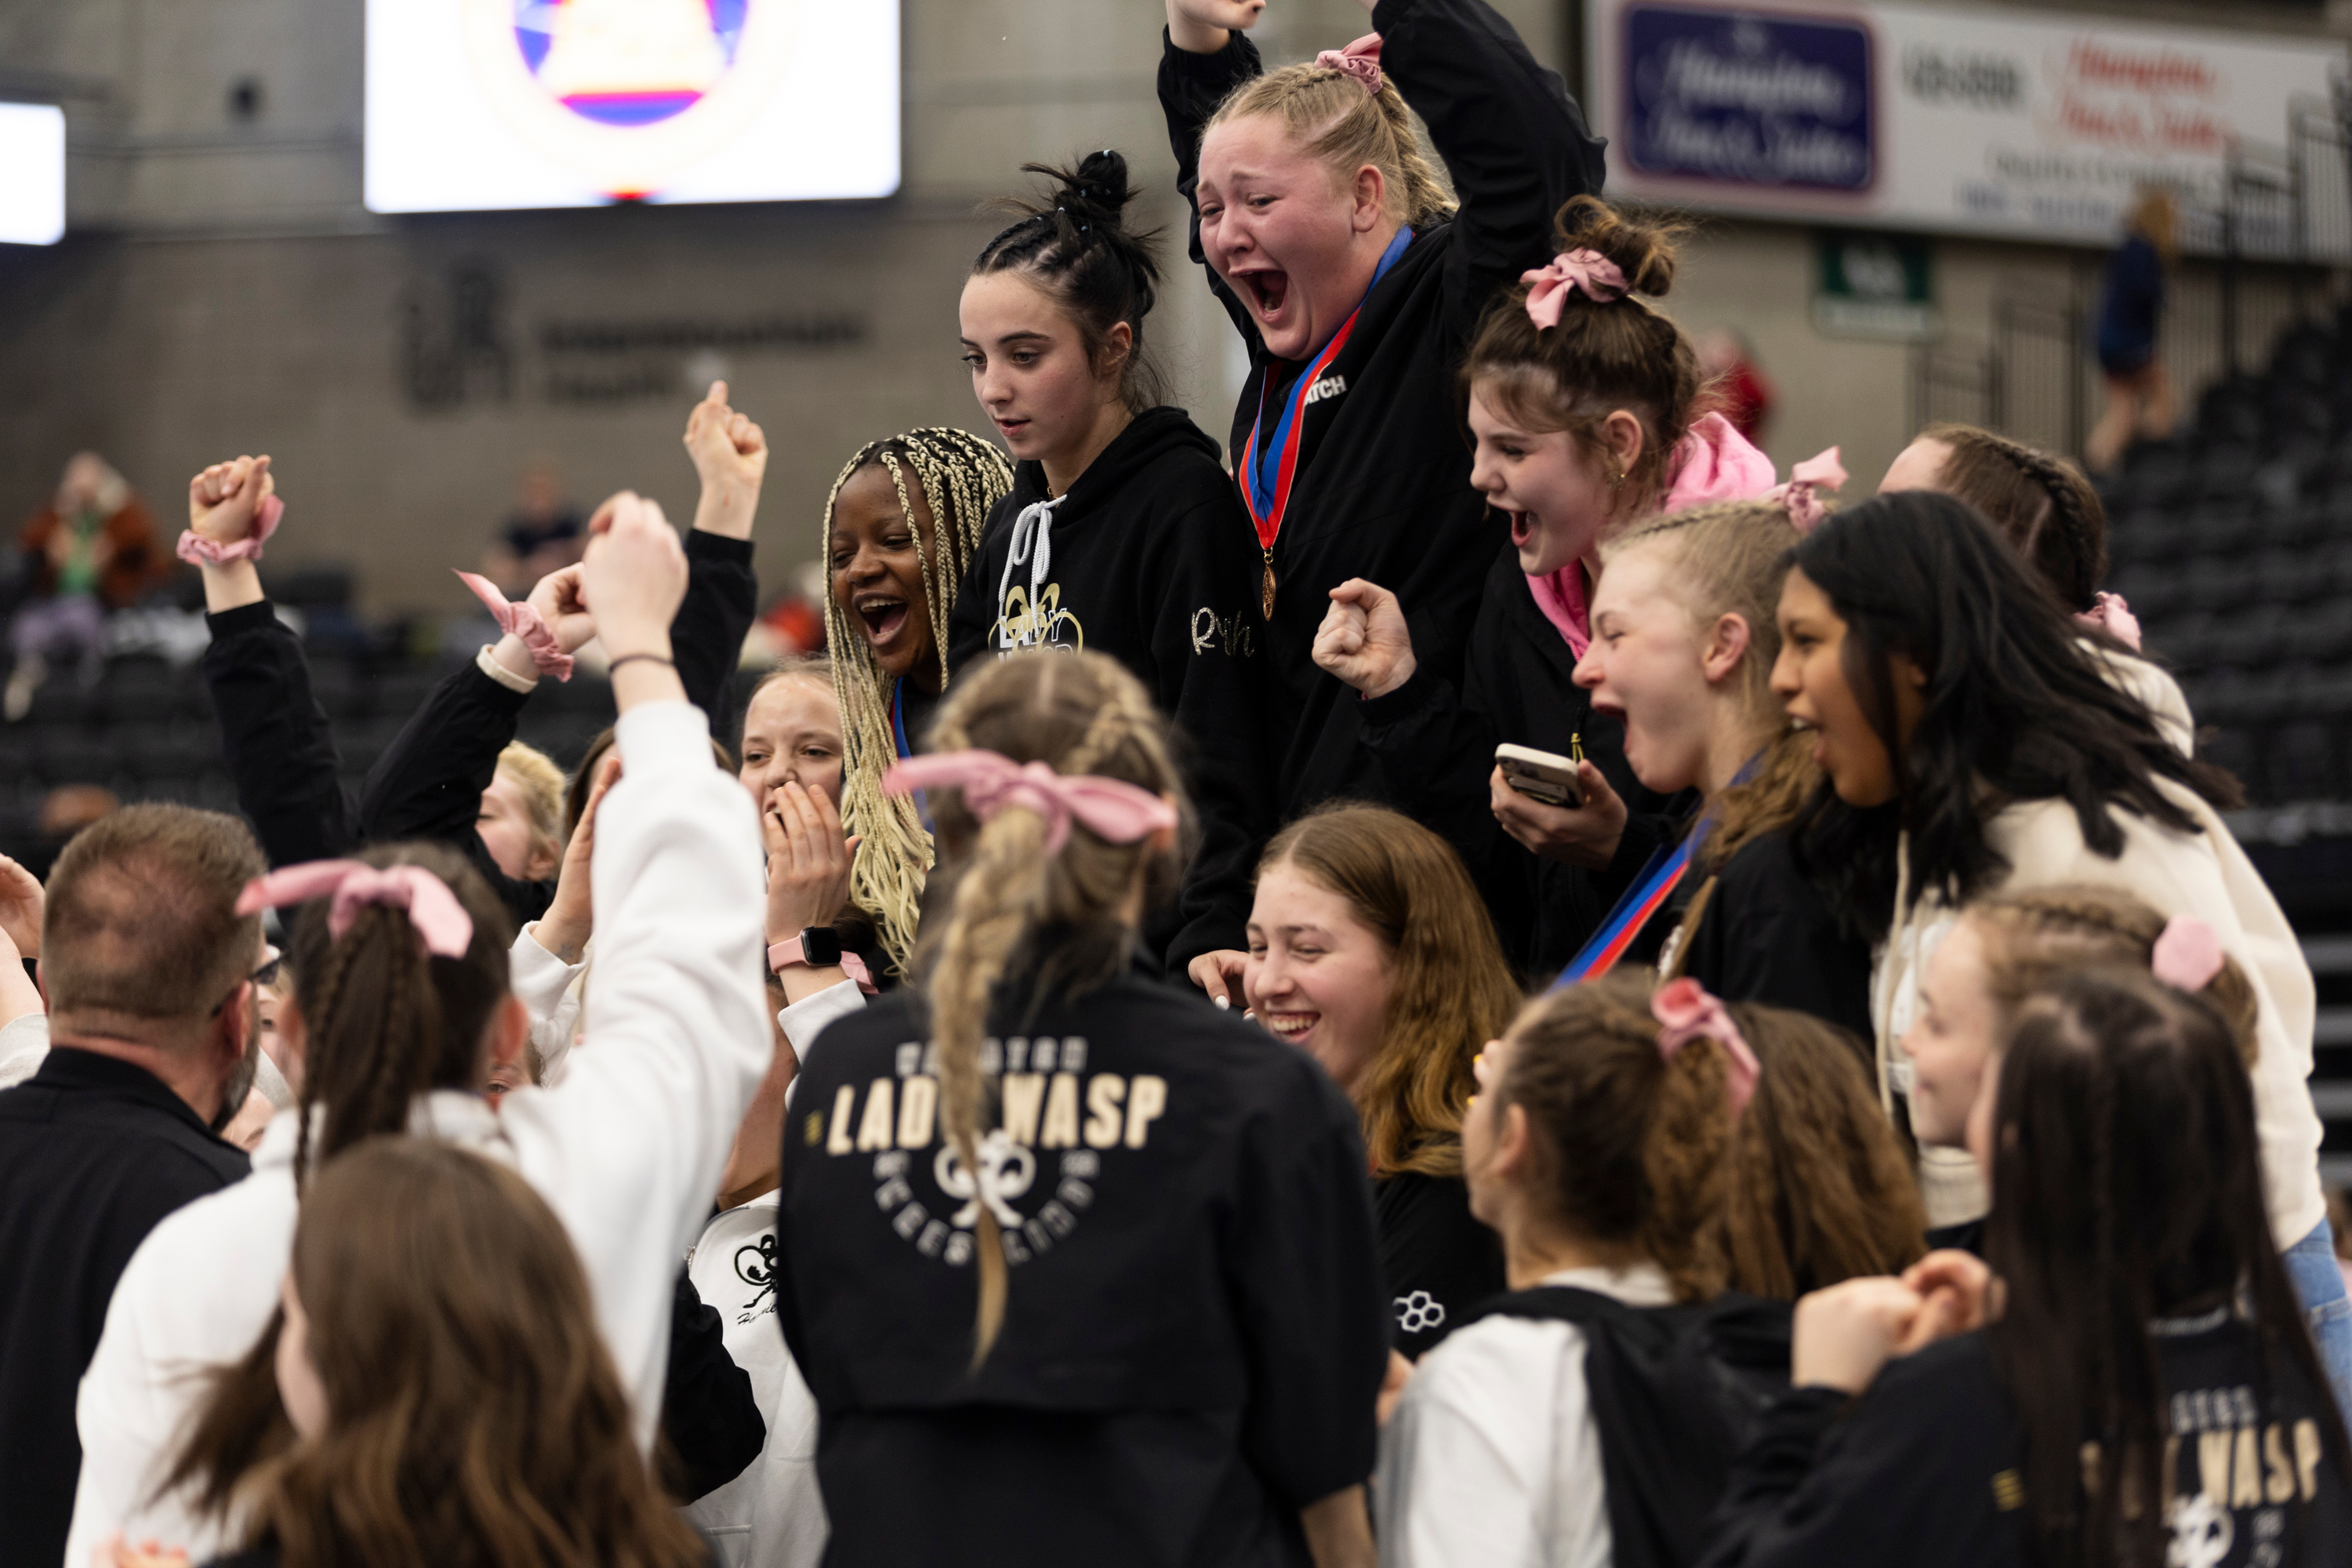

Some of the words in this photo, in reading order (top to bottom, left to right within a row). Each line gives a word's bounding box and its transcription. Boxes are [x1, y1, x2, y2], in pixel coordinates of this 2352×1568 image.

[1304, 374, 1348, 406] ATCH
[999, 608, 1067, 648] LADY
[826, 1075, 938, 1156] LAD
[1001, 1072, 1168, 1150] WASP
